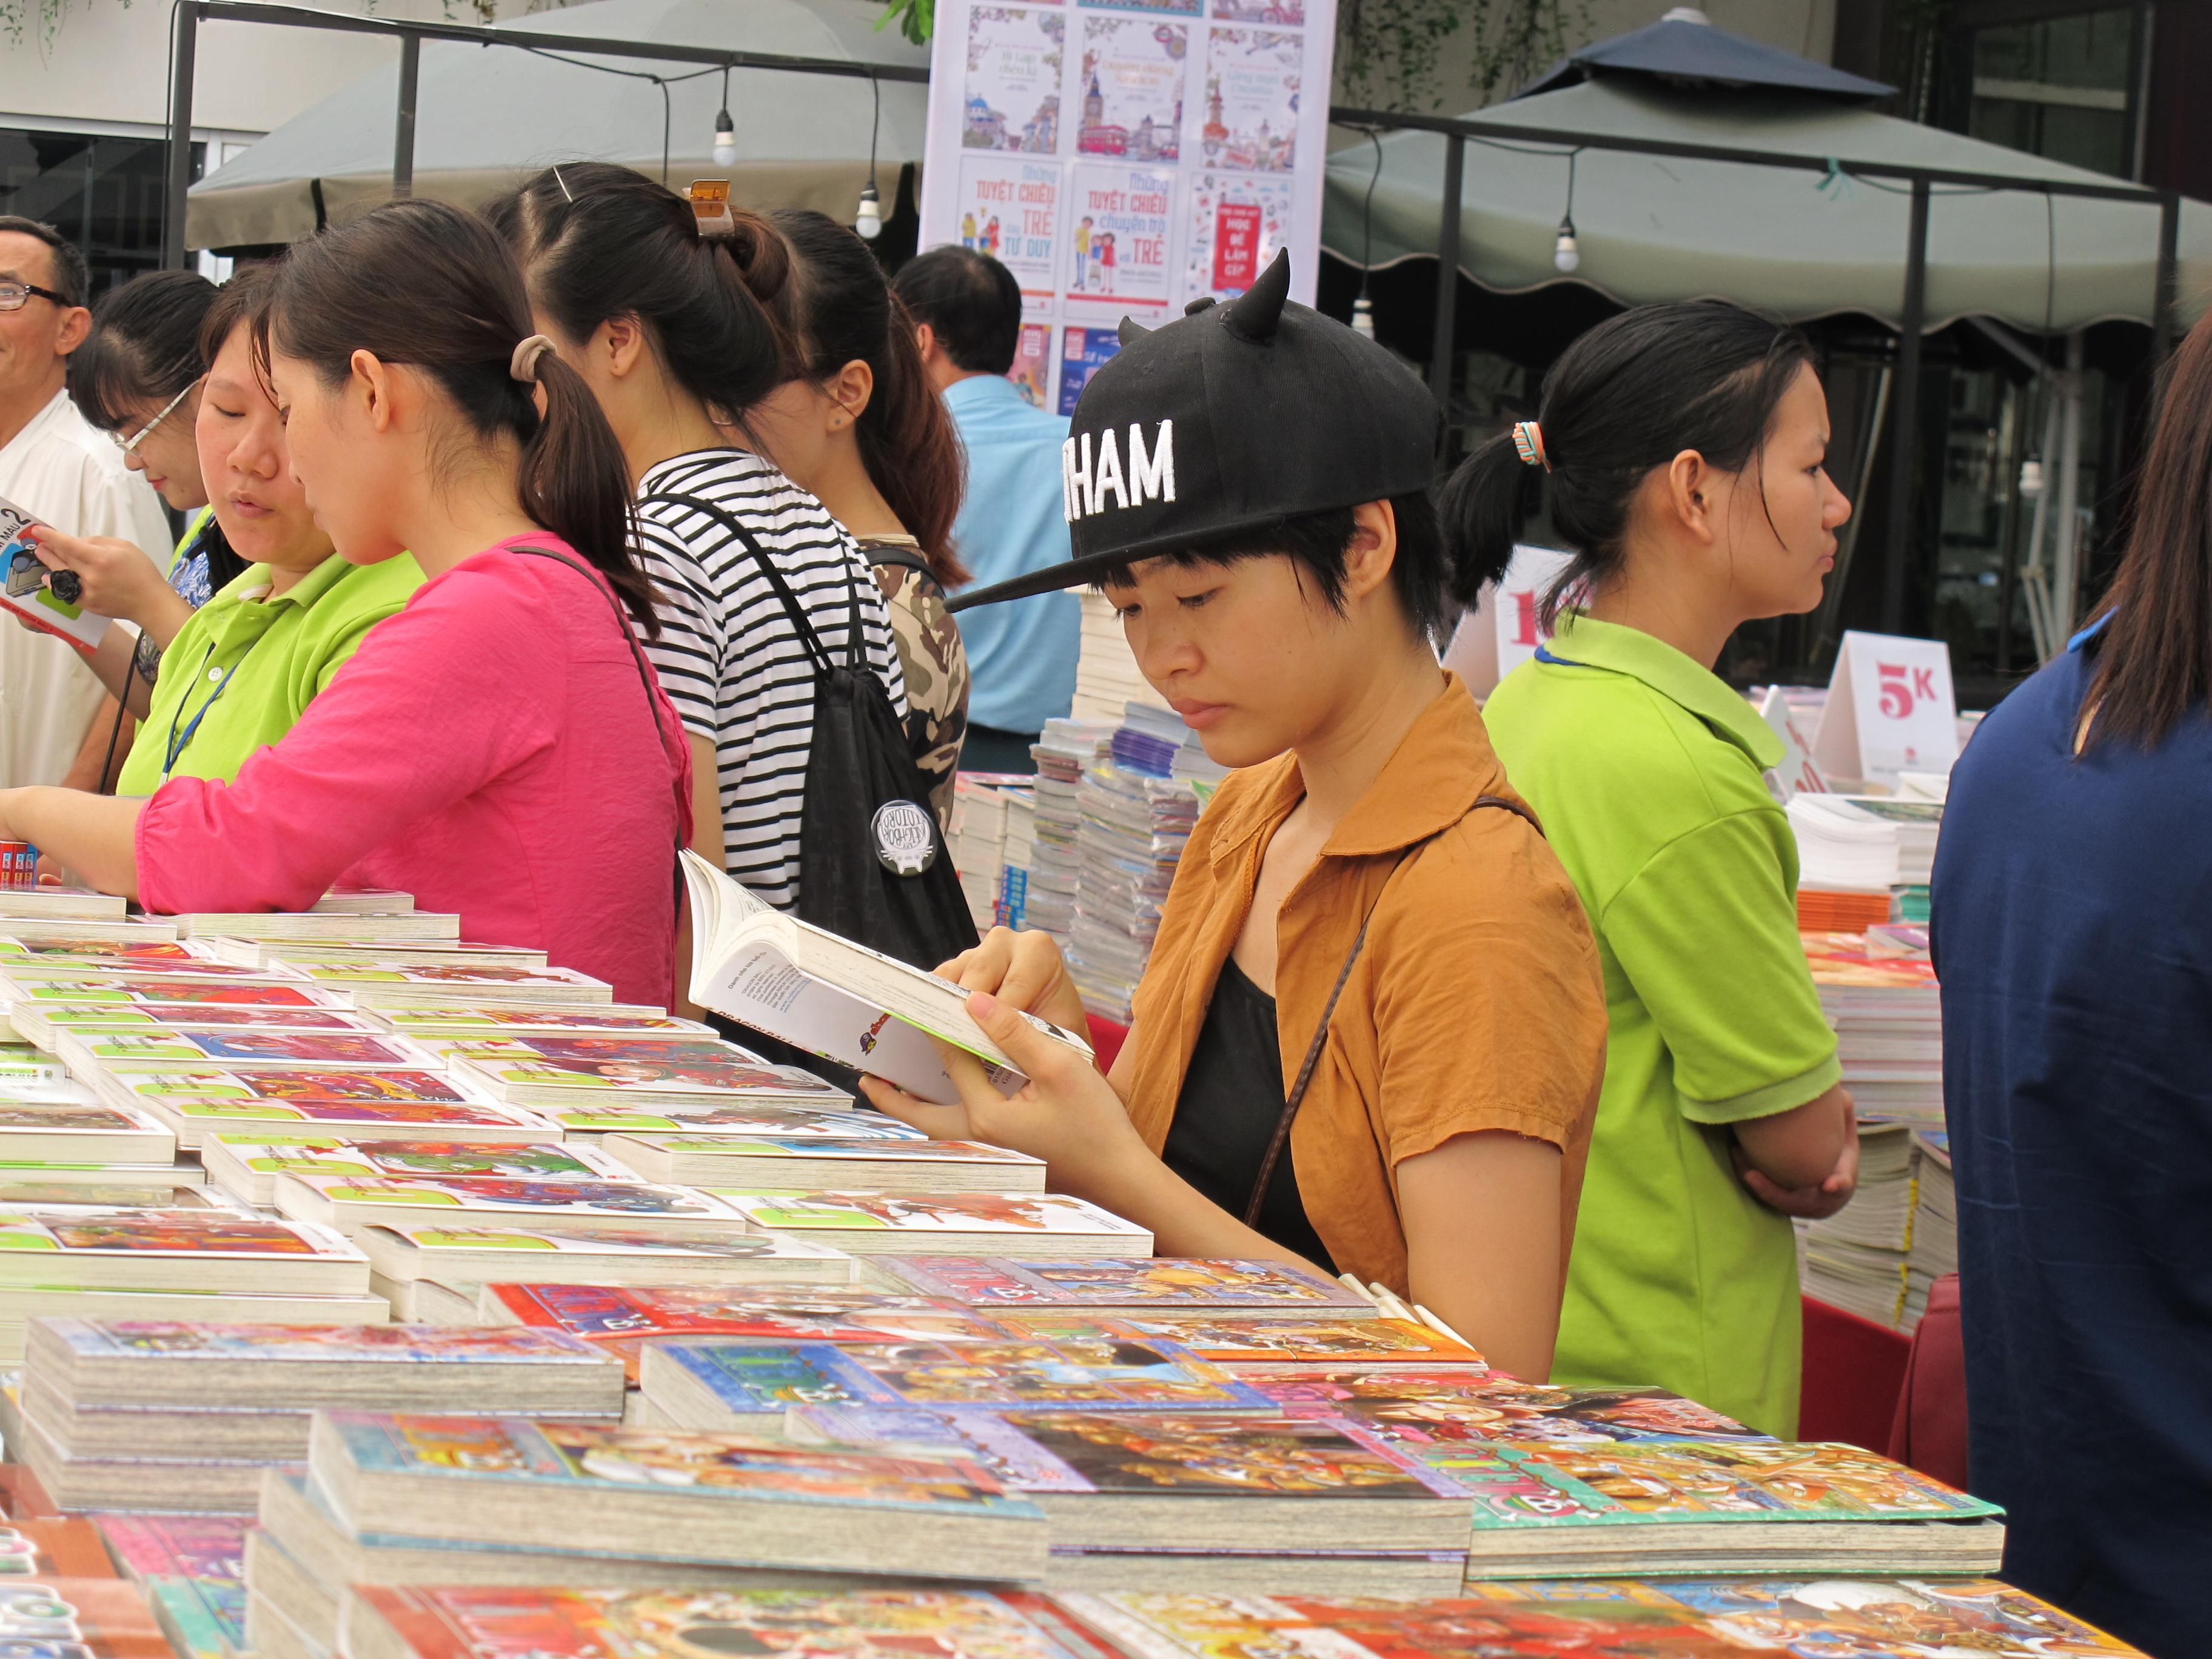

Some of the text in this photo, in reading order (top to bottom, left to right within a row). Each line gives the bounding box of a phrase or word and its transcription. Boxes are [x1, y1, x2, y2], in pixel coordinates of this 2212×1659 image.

[1, 508, 32, 526] 2
[1877, 660, 1937, 720] 5K
[883, 809, 923, 828] TOTORO
